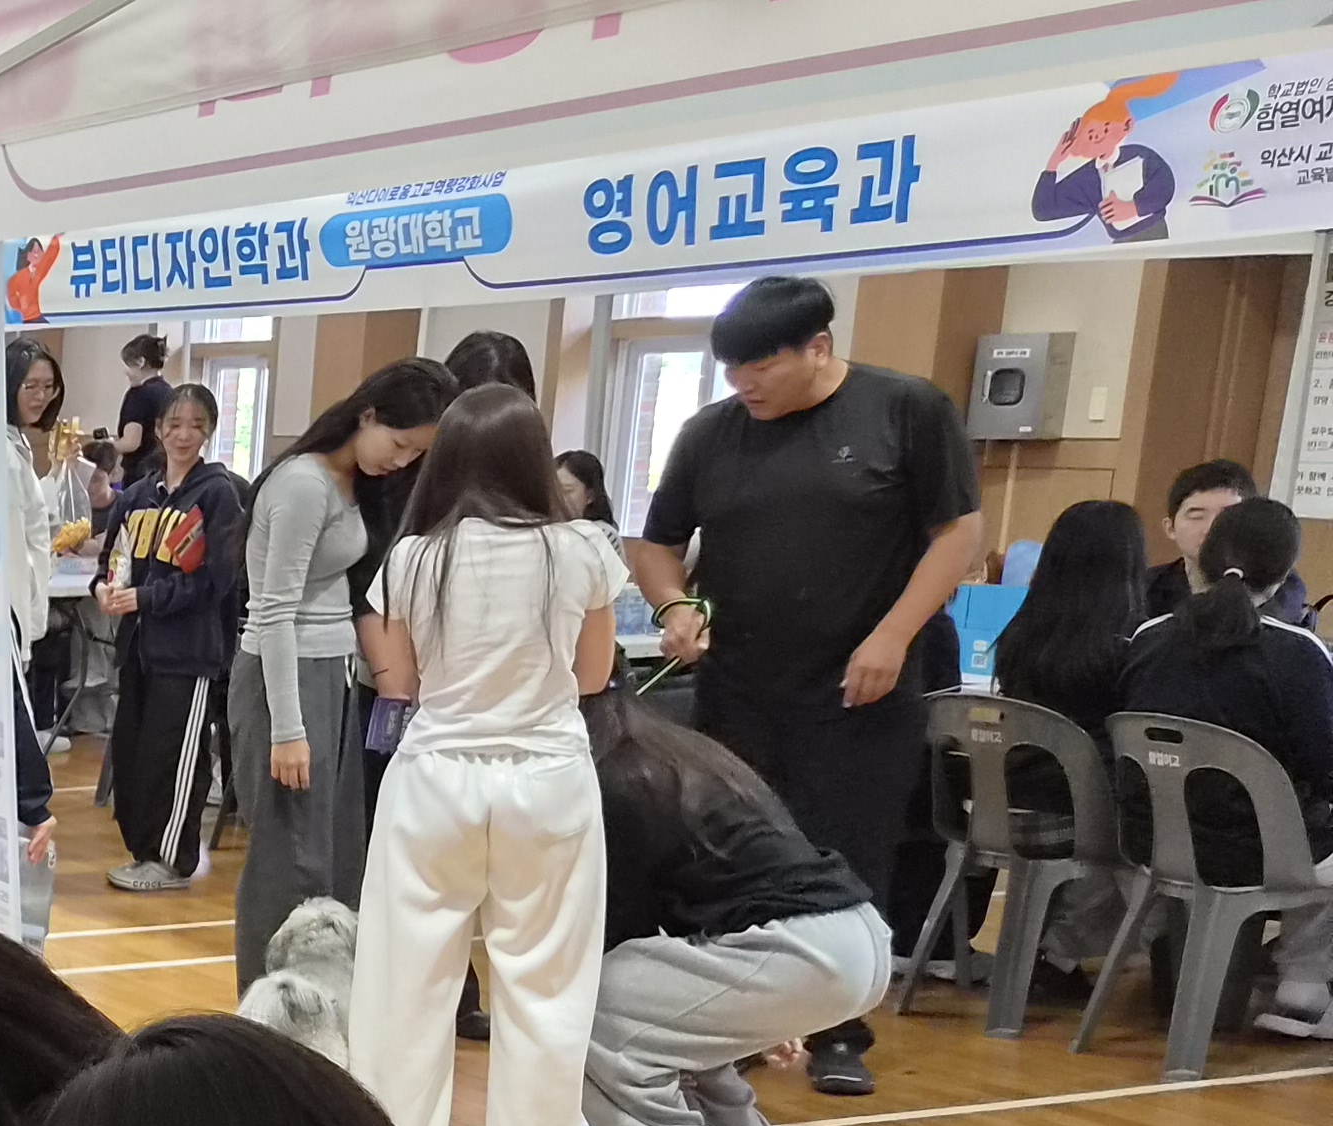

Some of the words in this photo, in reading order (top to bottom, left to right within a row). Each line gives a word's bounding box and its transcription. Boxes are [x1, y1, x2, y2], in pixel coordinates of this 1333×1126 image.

[1267, 78, 1324, 99] 학교법인
[1260, 144, 1313, 168] 익산시
[345, 171, 507, 206] 익산다이로움고교역량강화사업
[583, 133, 921, 256] 영어교육과
[344, 205, 484, 262] 원광대학교
[69, 216, 311, 300] 뷰티디자인학과
